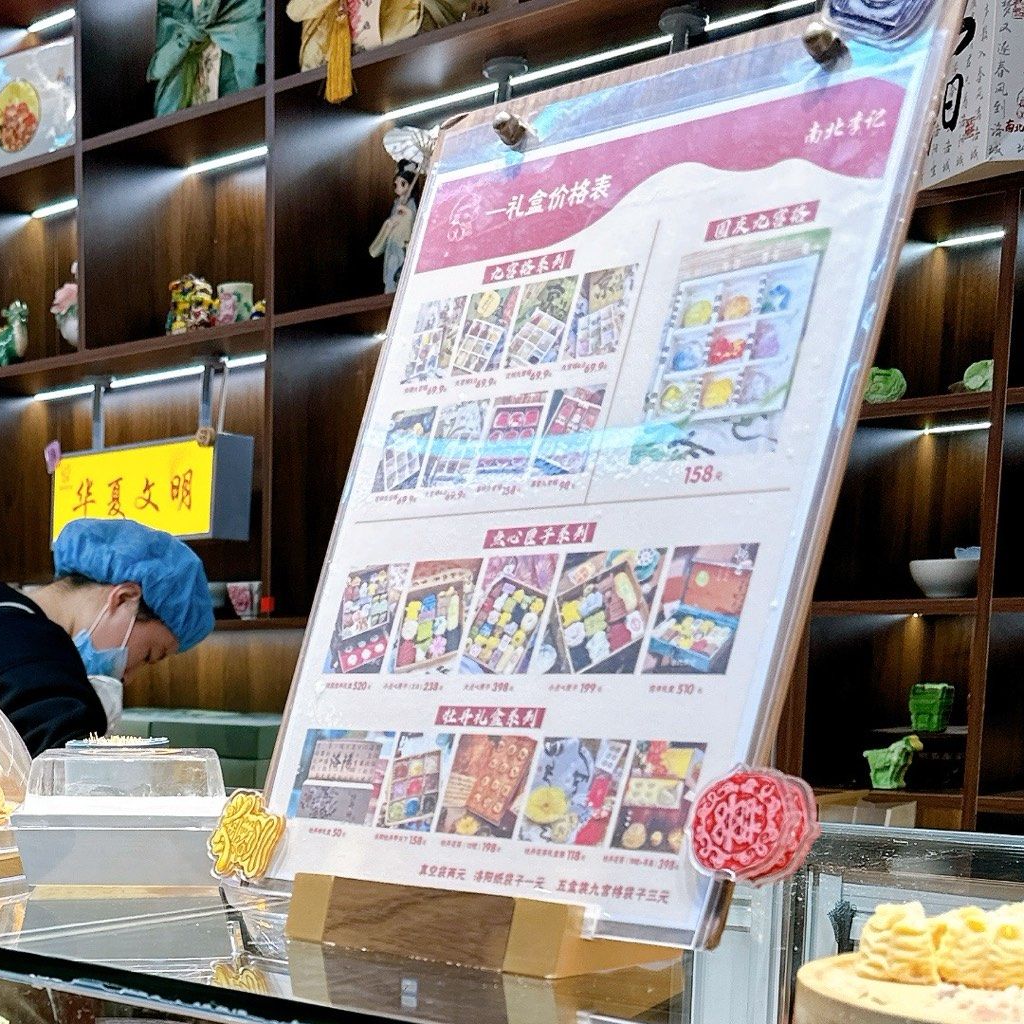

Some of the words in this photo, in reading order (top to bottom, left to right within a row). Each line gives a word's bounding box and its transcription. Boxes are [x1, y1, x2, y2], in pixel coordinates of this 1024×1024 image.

[72, 468, 193, 519] 华夏文明
[442, 707, 539, 728] 牡丹礼盒系列
